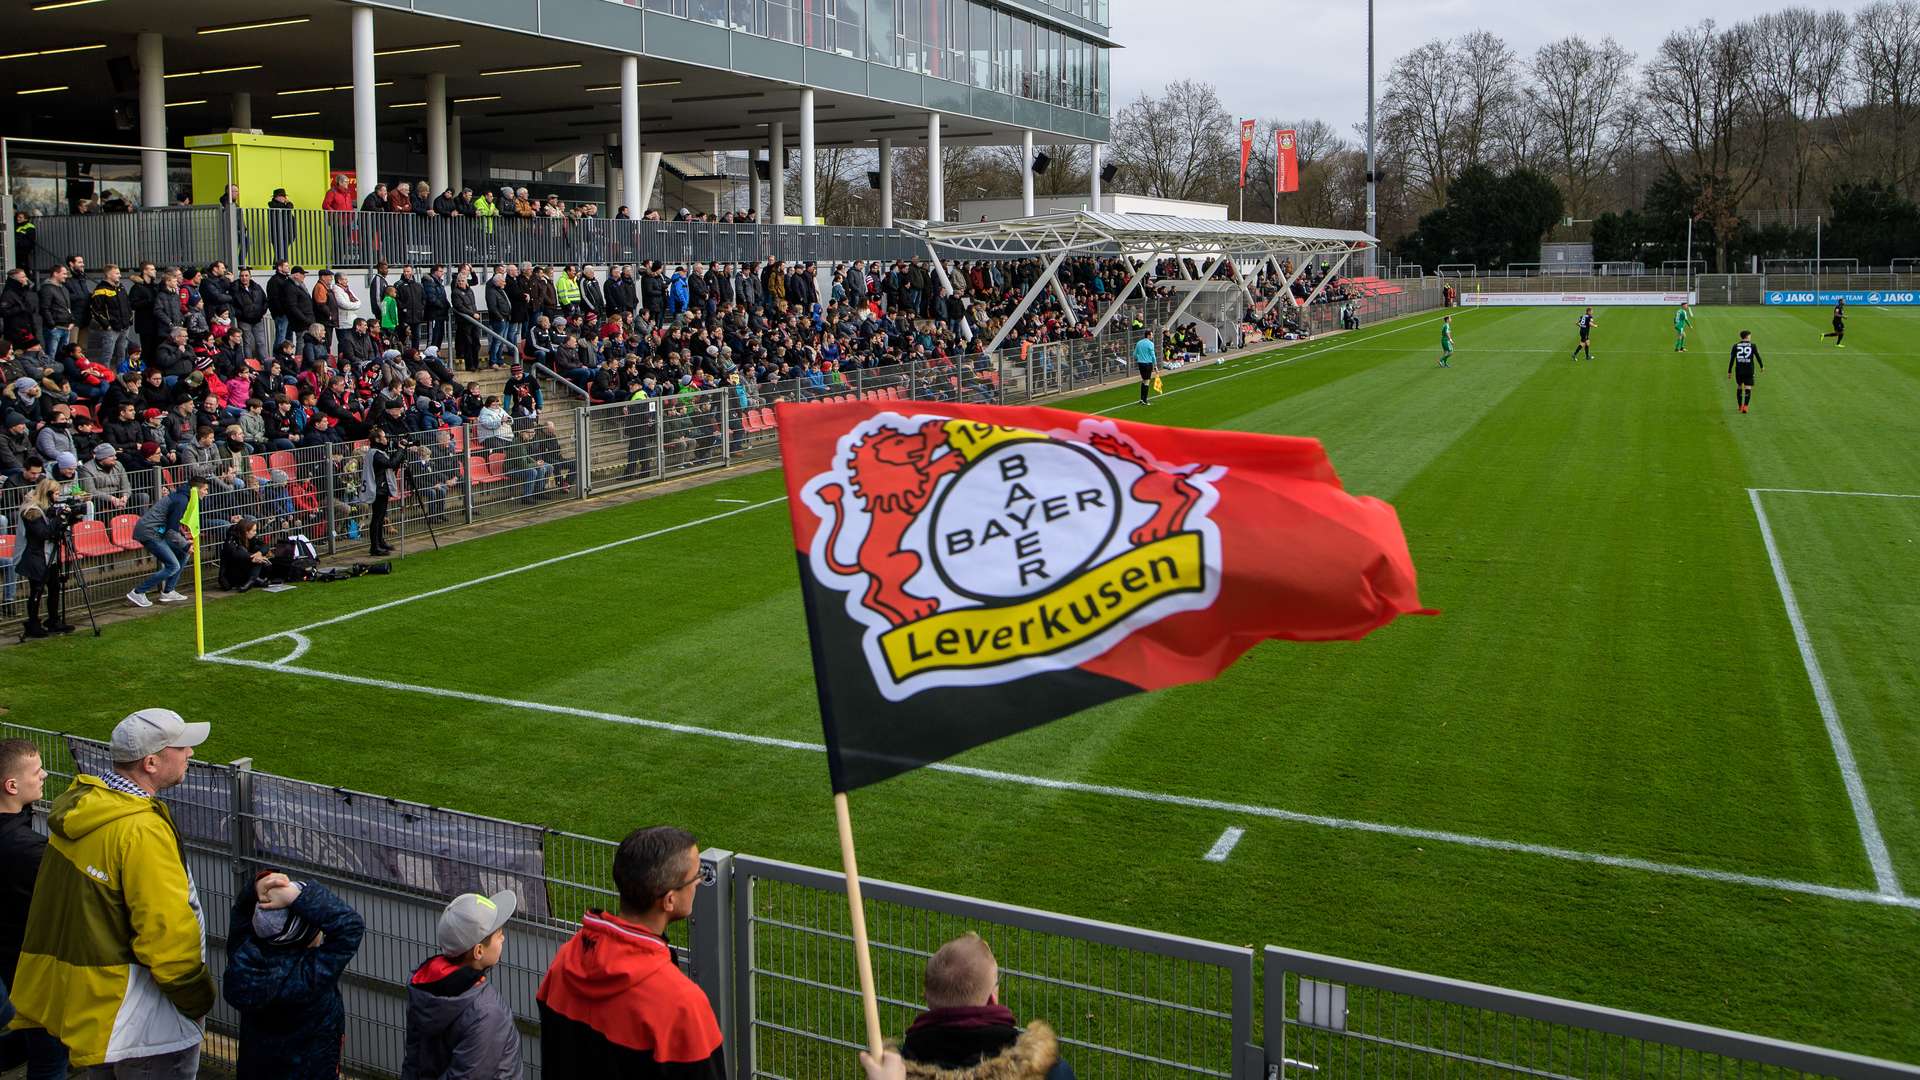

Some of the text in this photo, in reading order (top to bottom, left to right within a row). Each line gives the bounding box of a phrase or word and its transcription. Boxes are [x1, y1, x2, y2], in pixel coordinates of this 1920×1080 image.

[1785, 293, 1815, 303] JAKO
[1883, 293, 1914, 303] JAKO
[1736, 346, 1752, 359] 29
[946, 488, 1107, 556] BAYER
[998, 454, 1051, 587] BAYER
[907, 553, 1180, 662] Leverkusen
